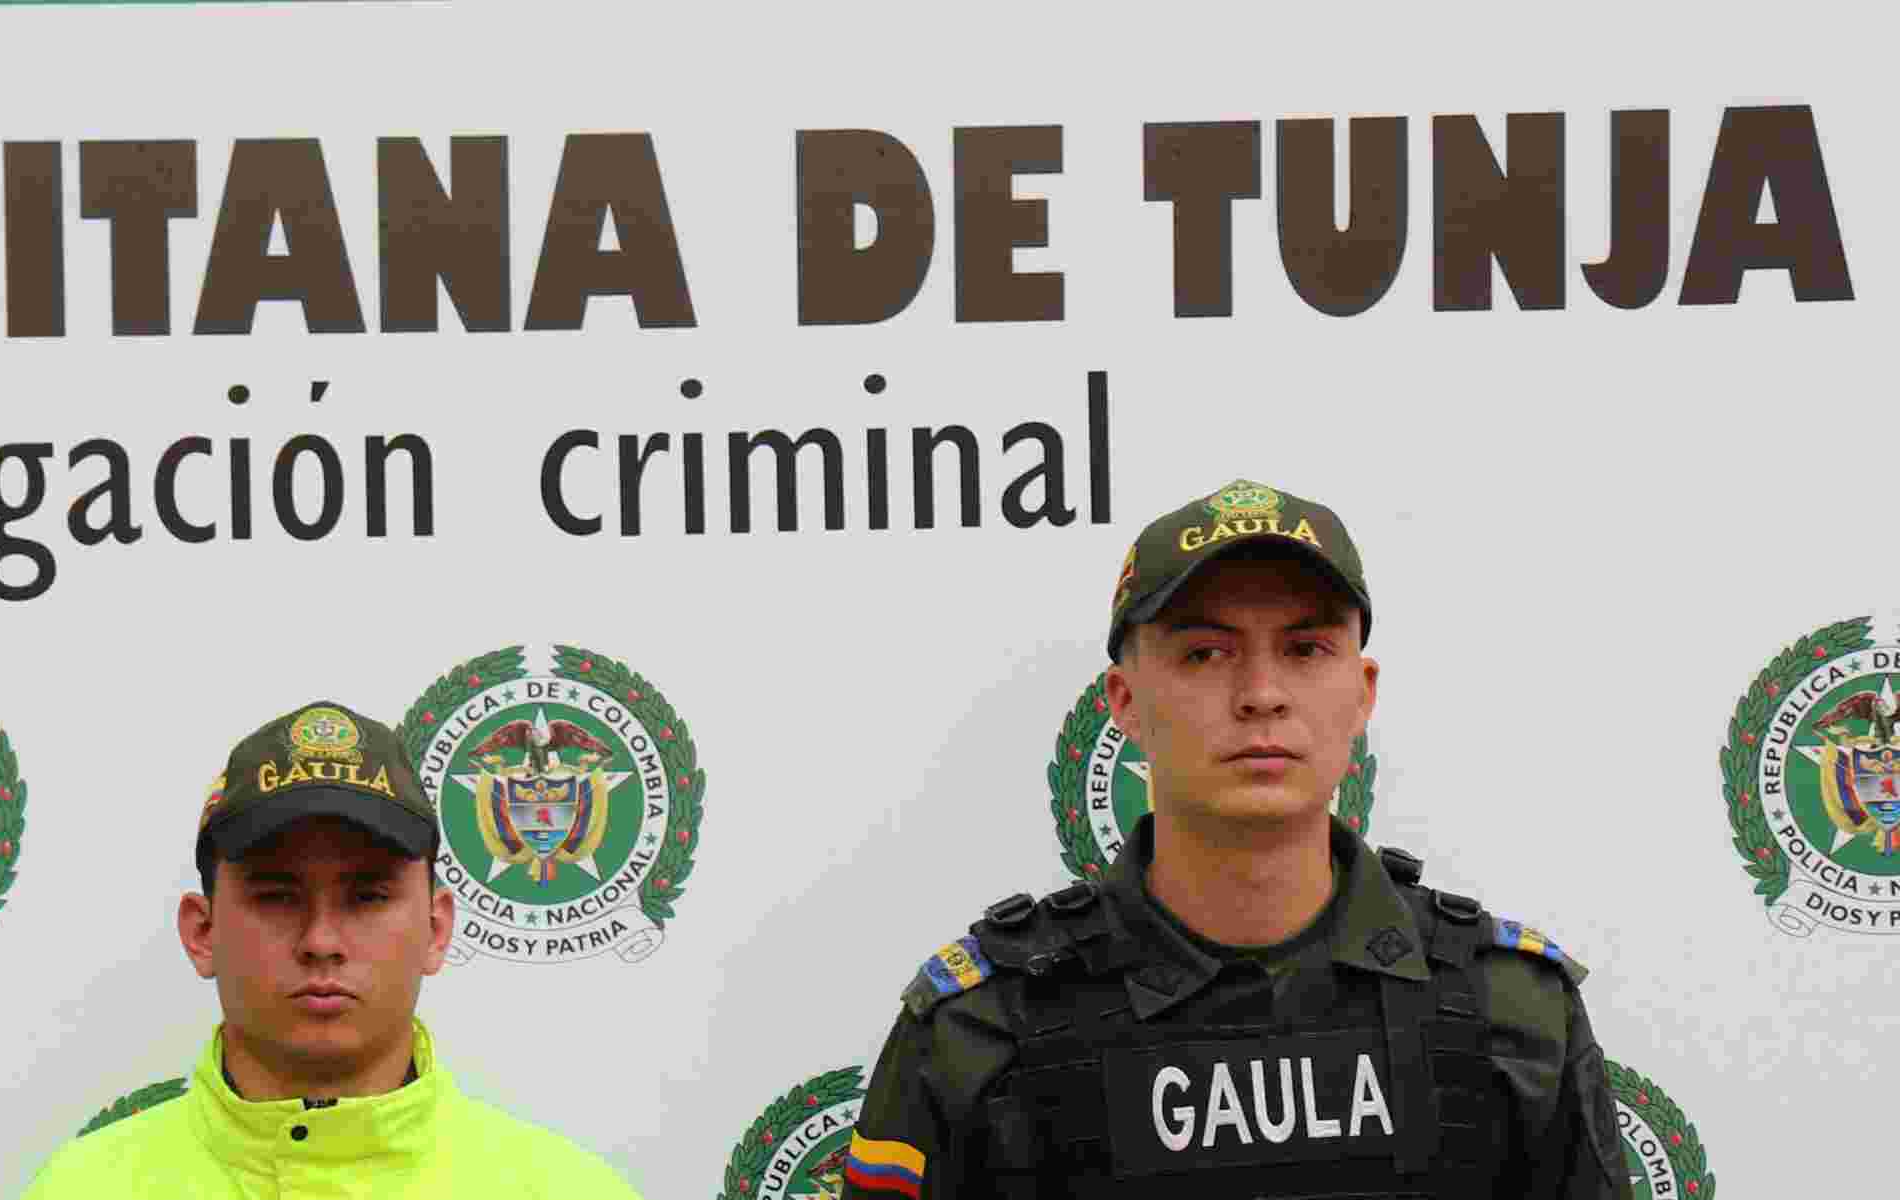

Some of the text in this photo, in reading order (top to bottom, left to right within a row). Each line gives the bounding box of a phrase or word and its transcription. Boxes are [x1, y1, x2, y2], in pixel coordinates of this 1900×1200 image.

[795, 124, 1066, 327] DE
[1142, 104, 1857, 319] TUNJA
[540, 370, 1111, 537] criminal
[1179, 517, 1323, 553] GAULA
[423, 681, 666, 819] PUBLICA DE COLOMBIA
[1092, 727, 1125, 811] REPUB
[1764, 665, 1845, 796] REPUBLICA
[258, 760, 396, 799] GAULA
[435, 849, 654, 925] POLICIA NACIONAL
[1779, 825, 1858, 893] POLICIA
[546, 919, 628, 956] PATRIA
[1151, 1053, 1395, 1152] GAULA
